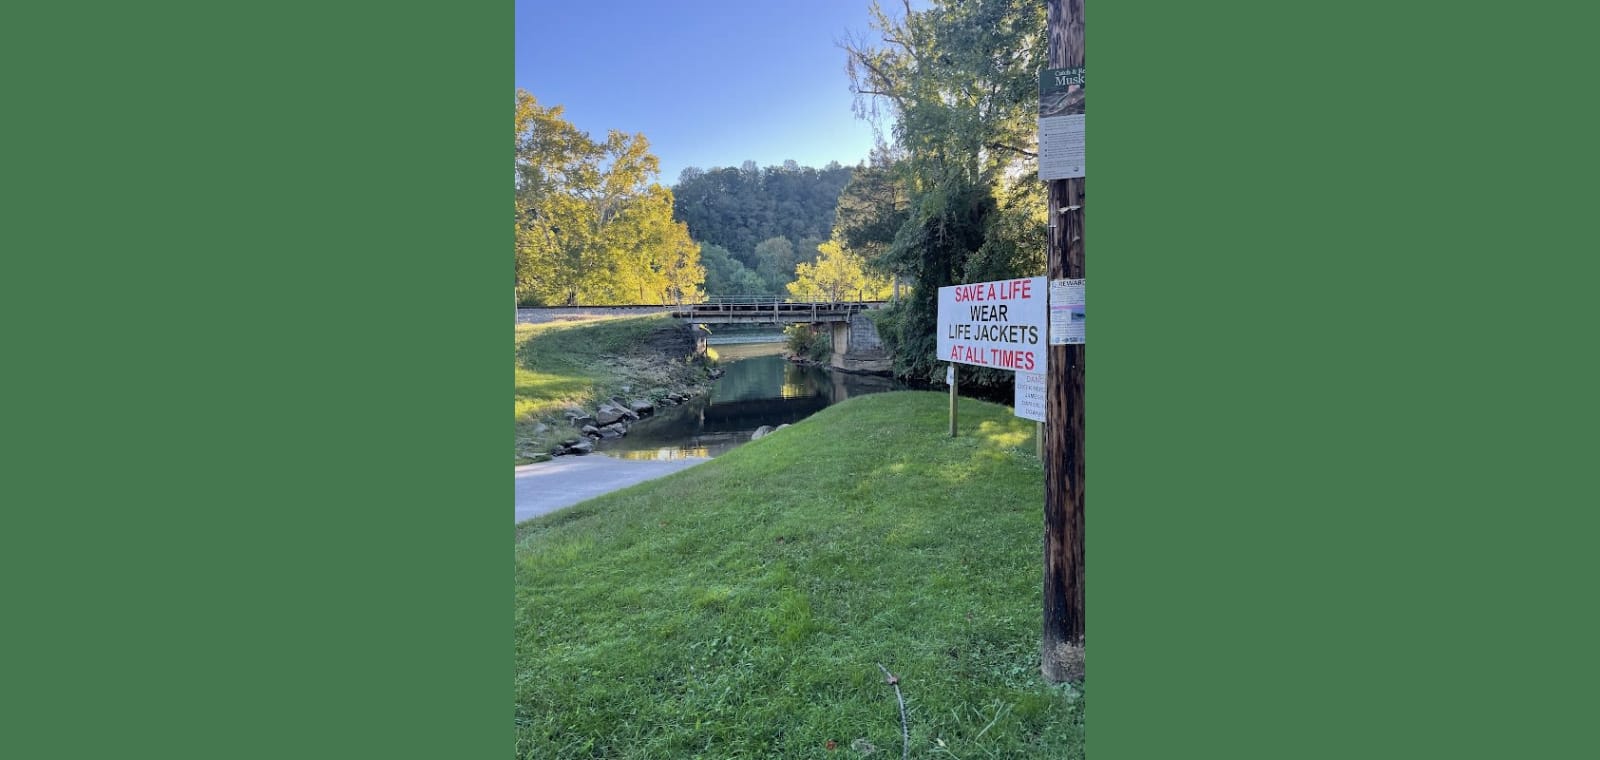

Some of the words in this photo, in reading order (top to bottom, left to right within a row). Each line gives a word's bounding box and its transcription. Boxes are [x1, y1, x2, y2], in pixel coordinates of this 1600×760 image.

[1055, 74, 1085, 85] Musk
[955, 284, 984, 303] SAVE
[987, 283, 997, 301] A
[1000, 279, 1032, 300] LIFE
[971, 305, 1008, 321] WEAR
[949, 325, 971, 340] LIFE
[974, 324, 1039, 345] JACKETS
[951, 345, 963, 361] AT
[965, 346, 988, 365] ALL
[991, 349, 1035, 371] TIMES
